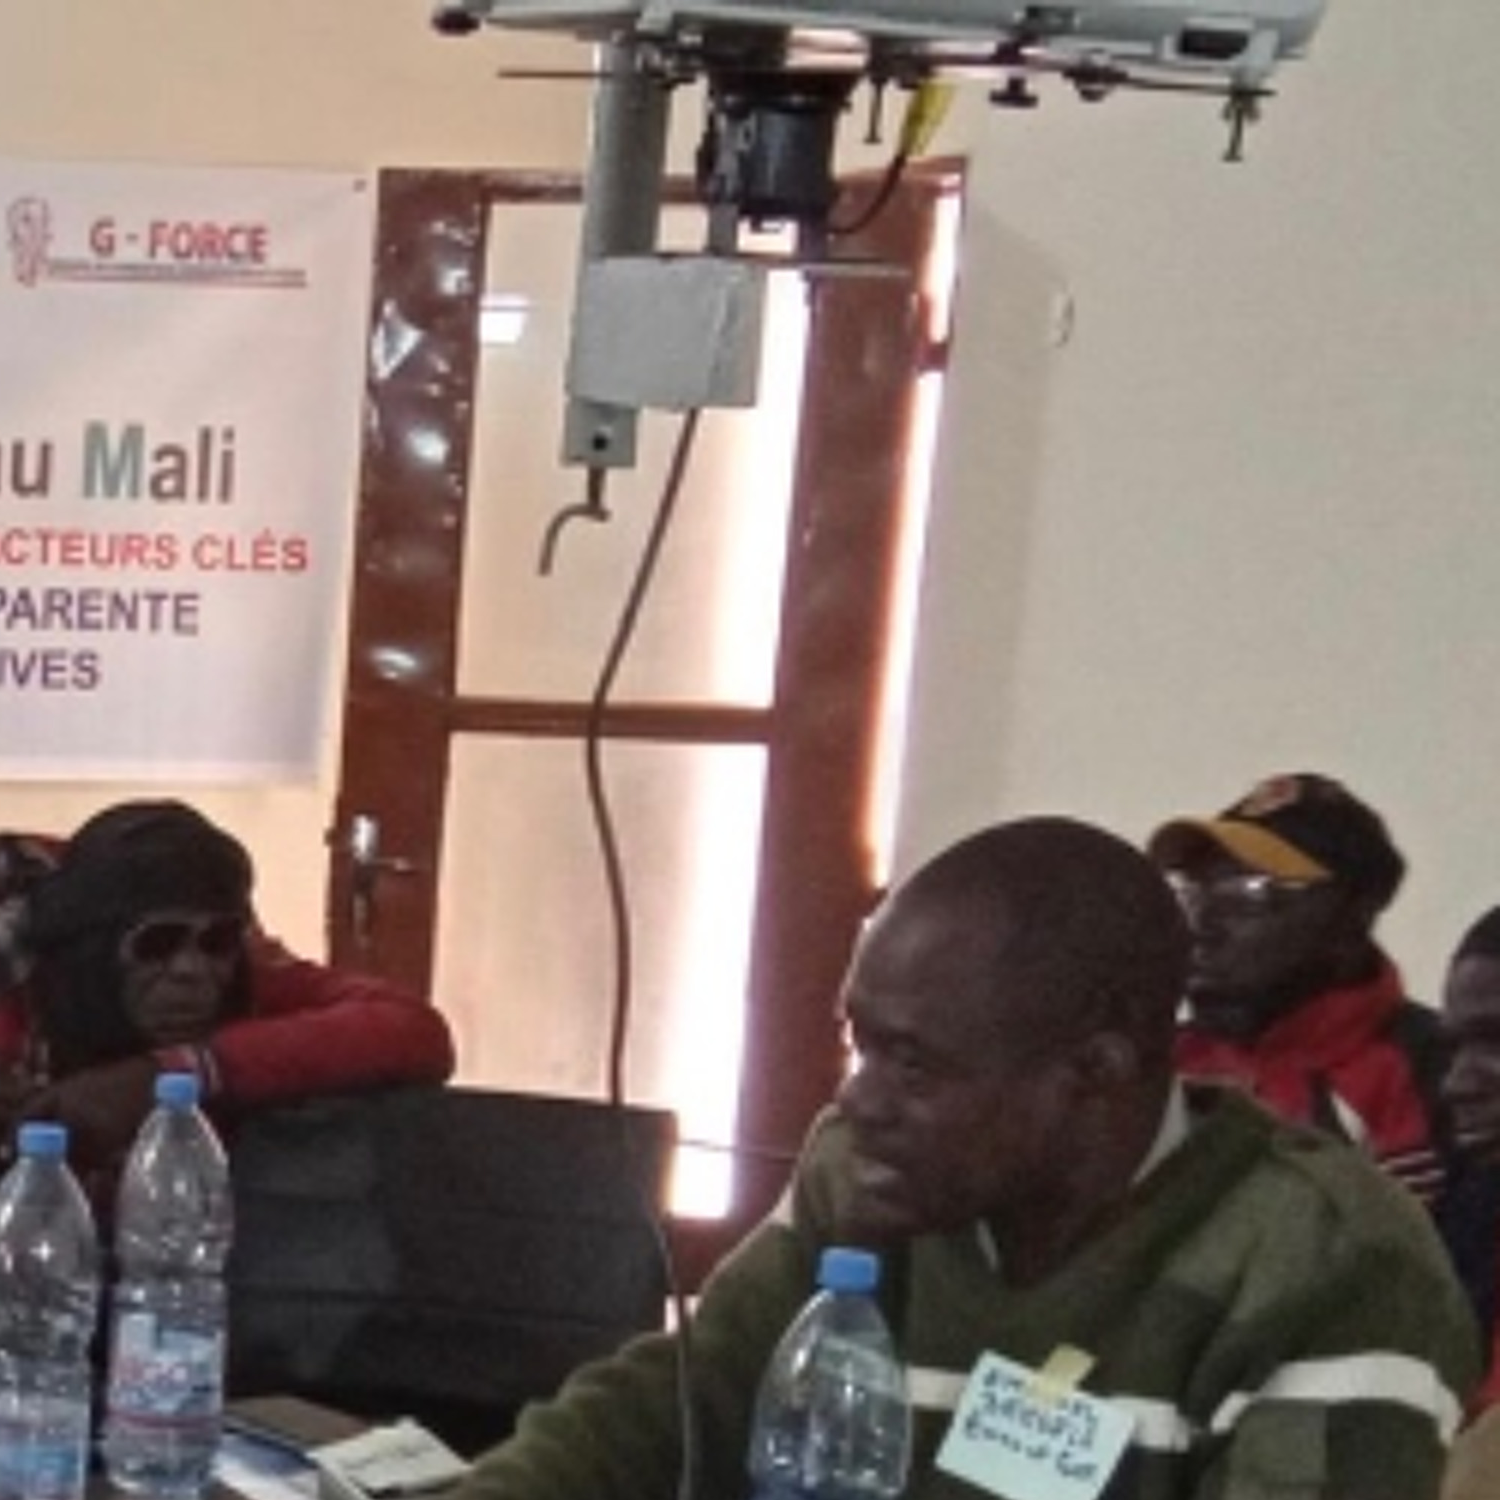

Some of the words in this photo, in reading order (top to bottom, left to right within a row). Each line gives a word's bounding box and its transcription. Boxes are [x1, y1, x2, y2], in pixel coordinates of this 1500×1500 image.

[148, 219, 268, 264] FORCE
[83, 421, 236, 504] Mali
[193, 530, 310, 573] CLÉS
